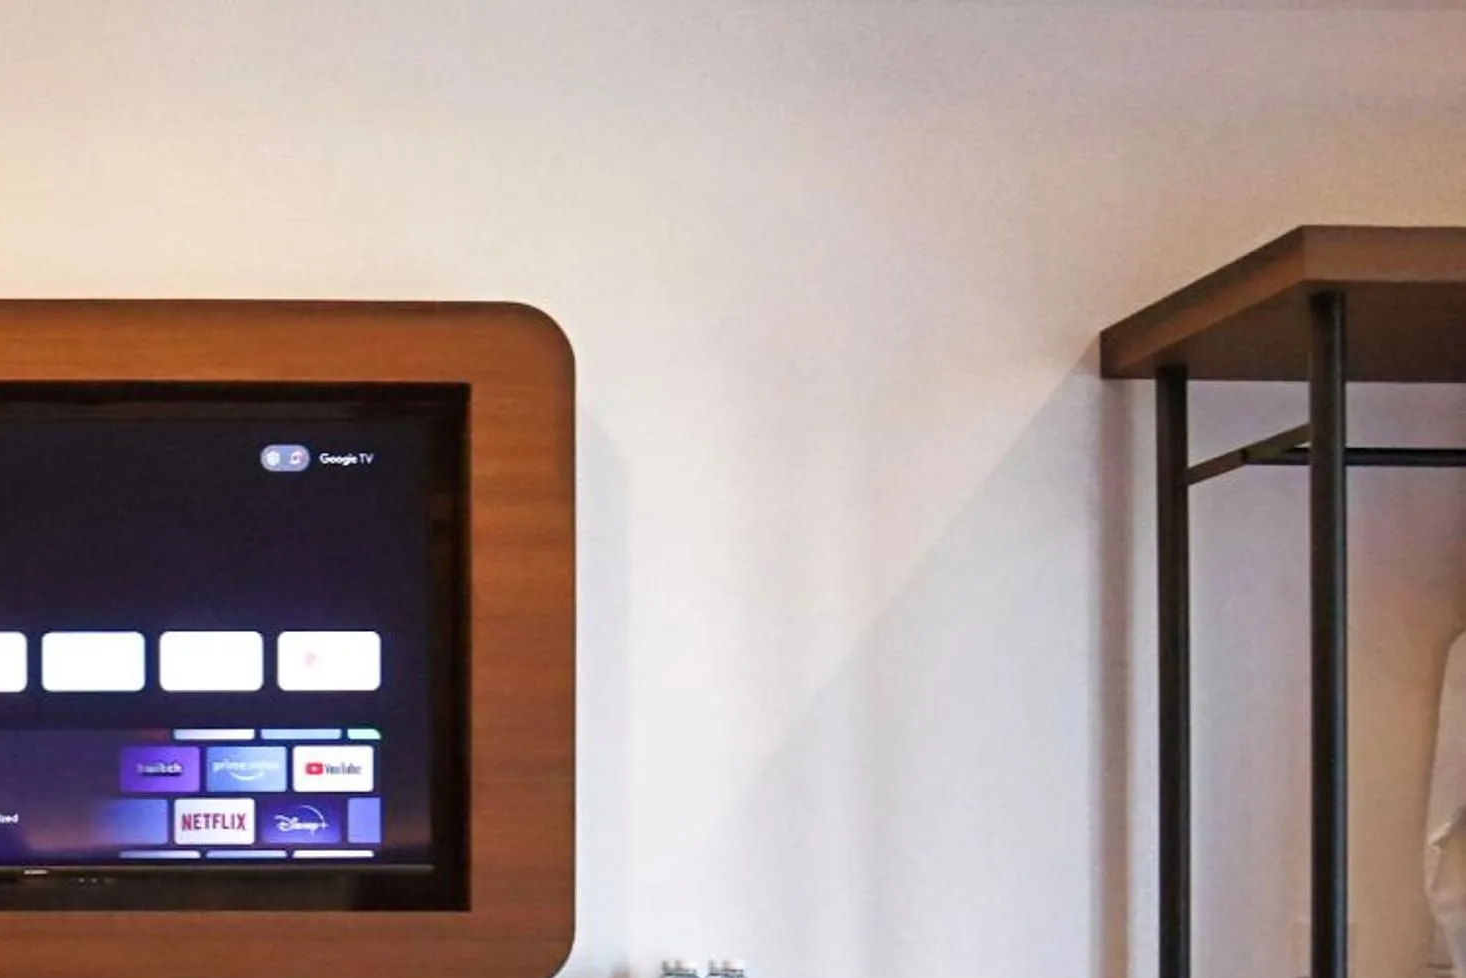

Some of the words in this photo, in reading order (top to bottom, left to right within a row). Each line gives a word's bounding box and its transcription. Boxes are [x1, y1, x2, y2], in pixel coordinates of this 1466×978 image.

[319, 453, 357, 465] Google
[359, 453, 374, 464] TV
[324, 763, 362, 774] YouTube
[181, 814, 246, 831] NETFLIX
